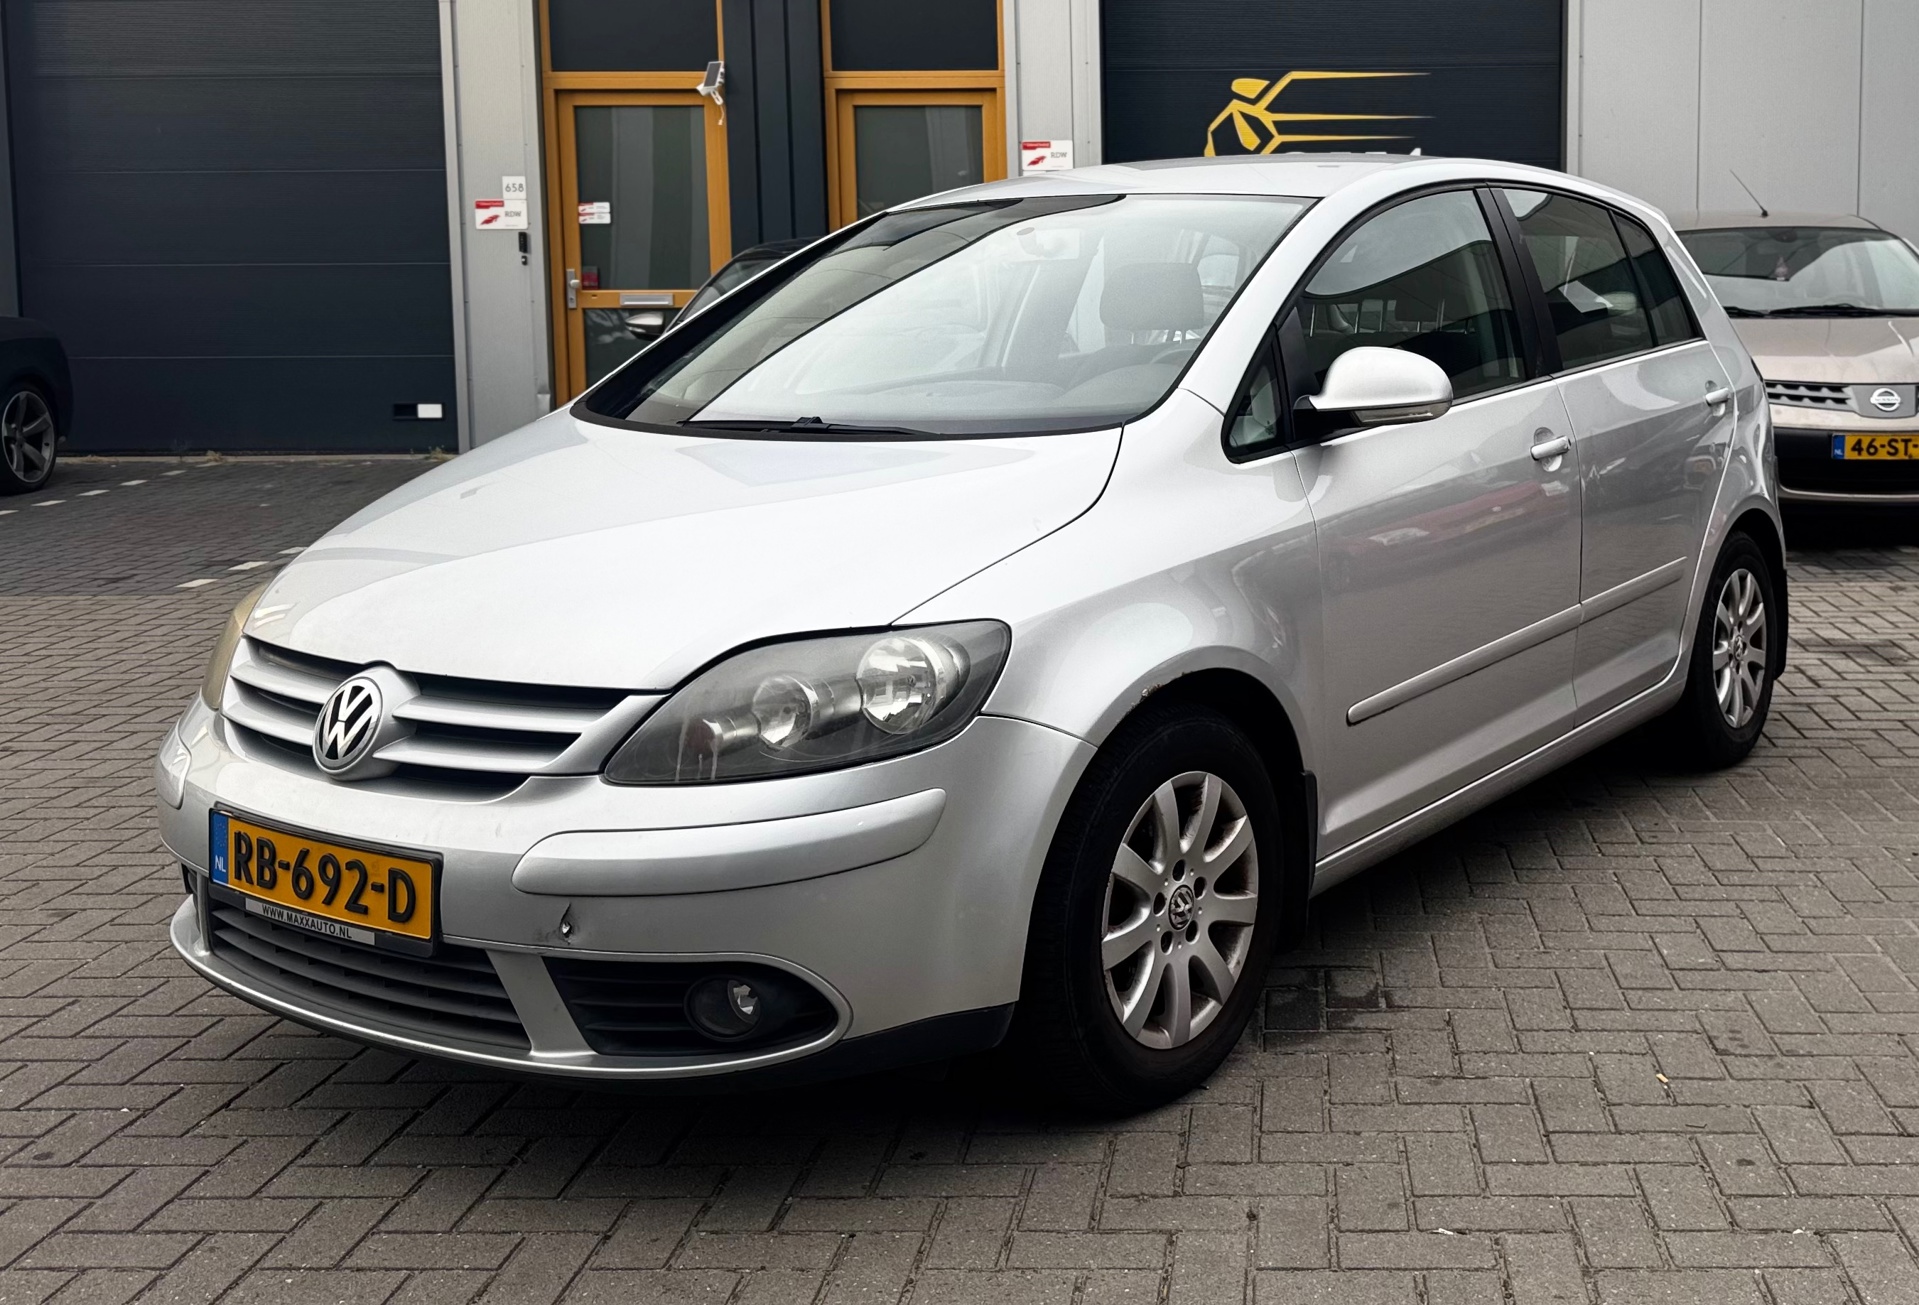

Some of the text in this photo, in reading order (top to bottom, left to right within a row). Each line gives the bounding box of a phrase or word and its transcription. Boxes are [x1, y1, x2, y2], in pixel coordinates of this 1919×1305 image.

[505, 183, 524, 192] 658
[215, 855, 226, 872] NL
[234, 831, 416, 923] RB-692-D
[262, 904, 352, 939] WWW.MAXXAUTO.NL
